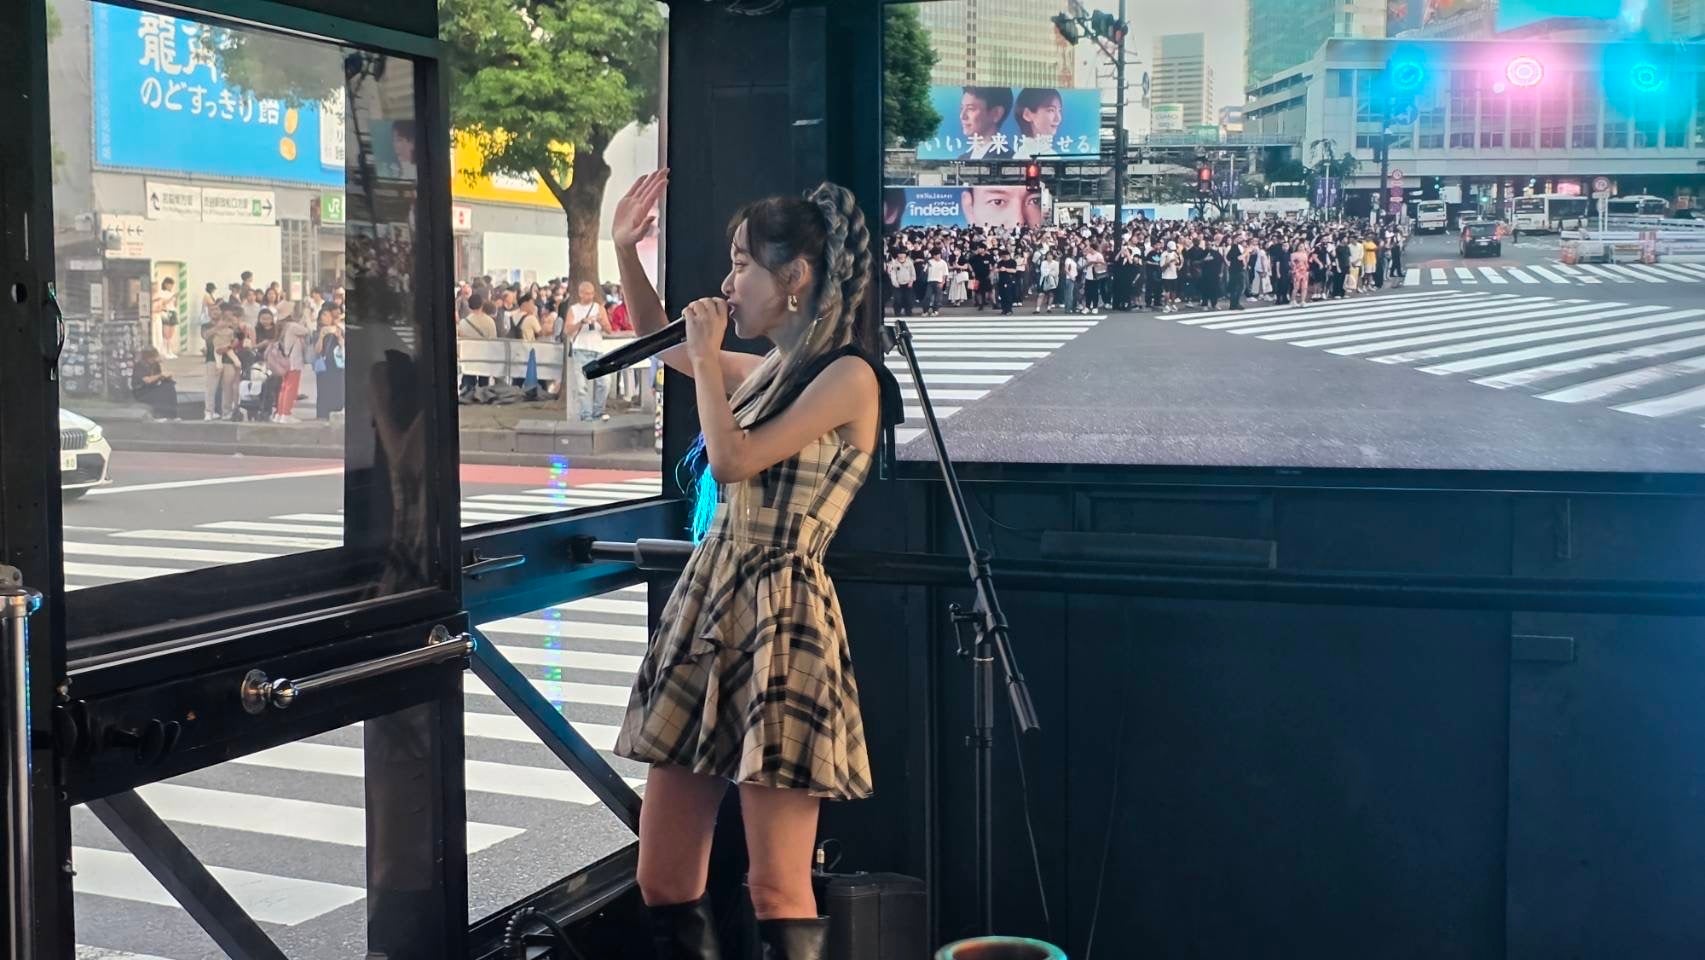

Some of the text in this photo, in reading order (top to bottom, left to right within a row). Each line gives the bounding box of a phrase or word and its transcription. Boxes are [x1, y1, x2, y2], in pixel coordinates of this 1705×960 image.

[140, 77, 280, 125] のどすっきり飴
[328, 198, 341, 213] JR
[910, 202, 959, 216] indeed
